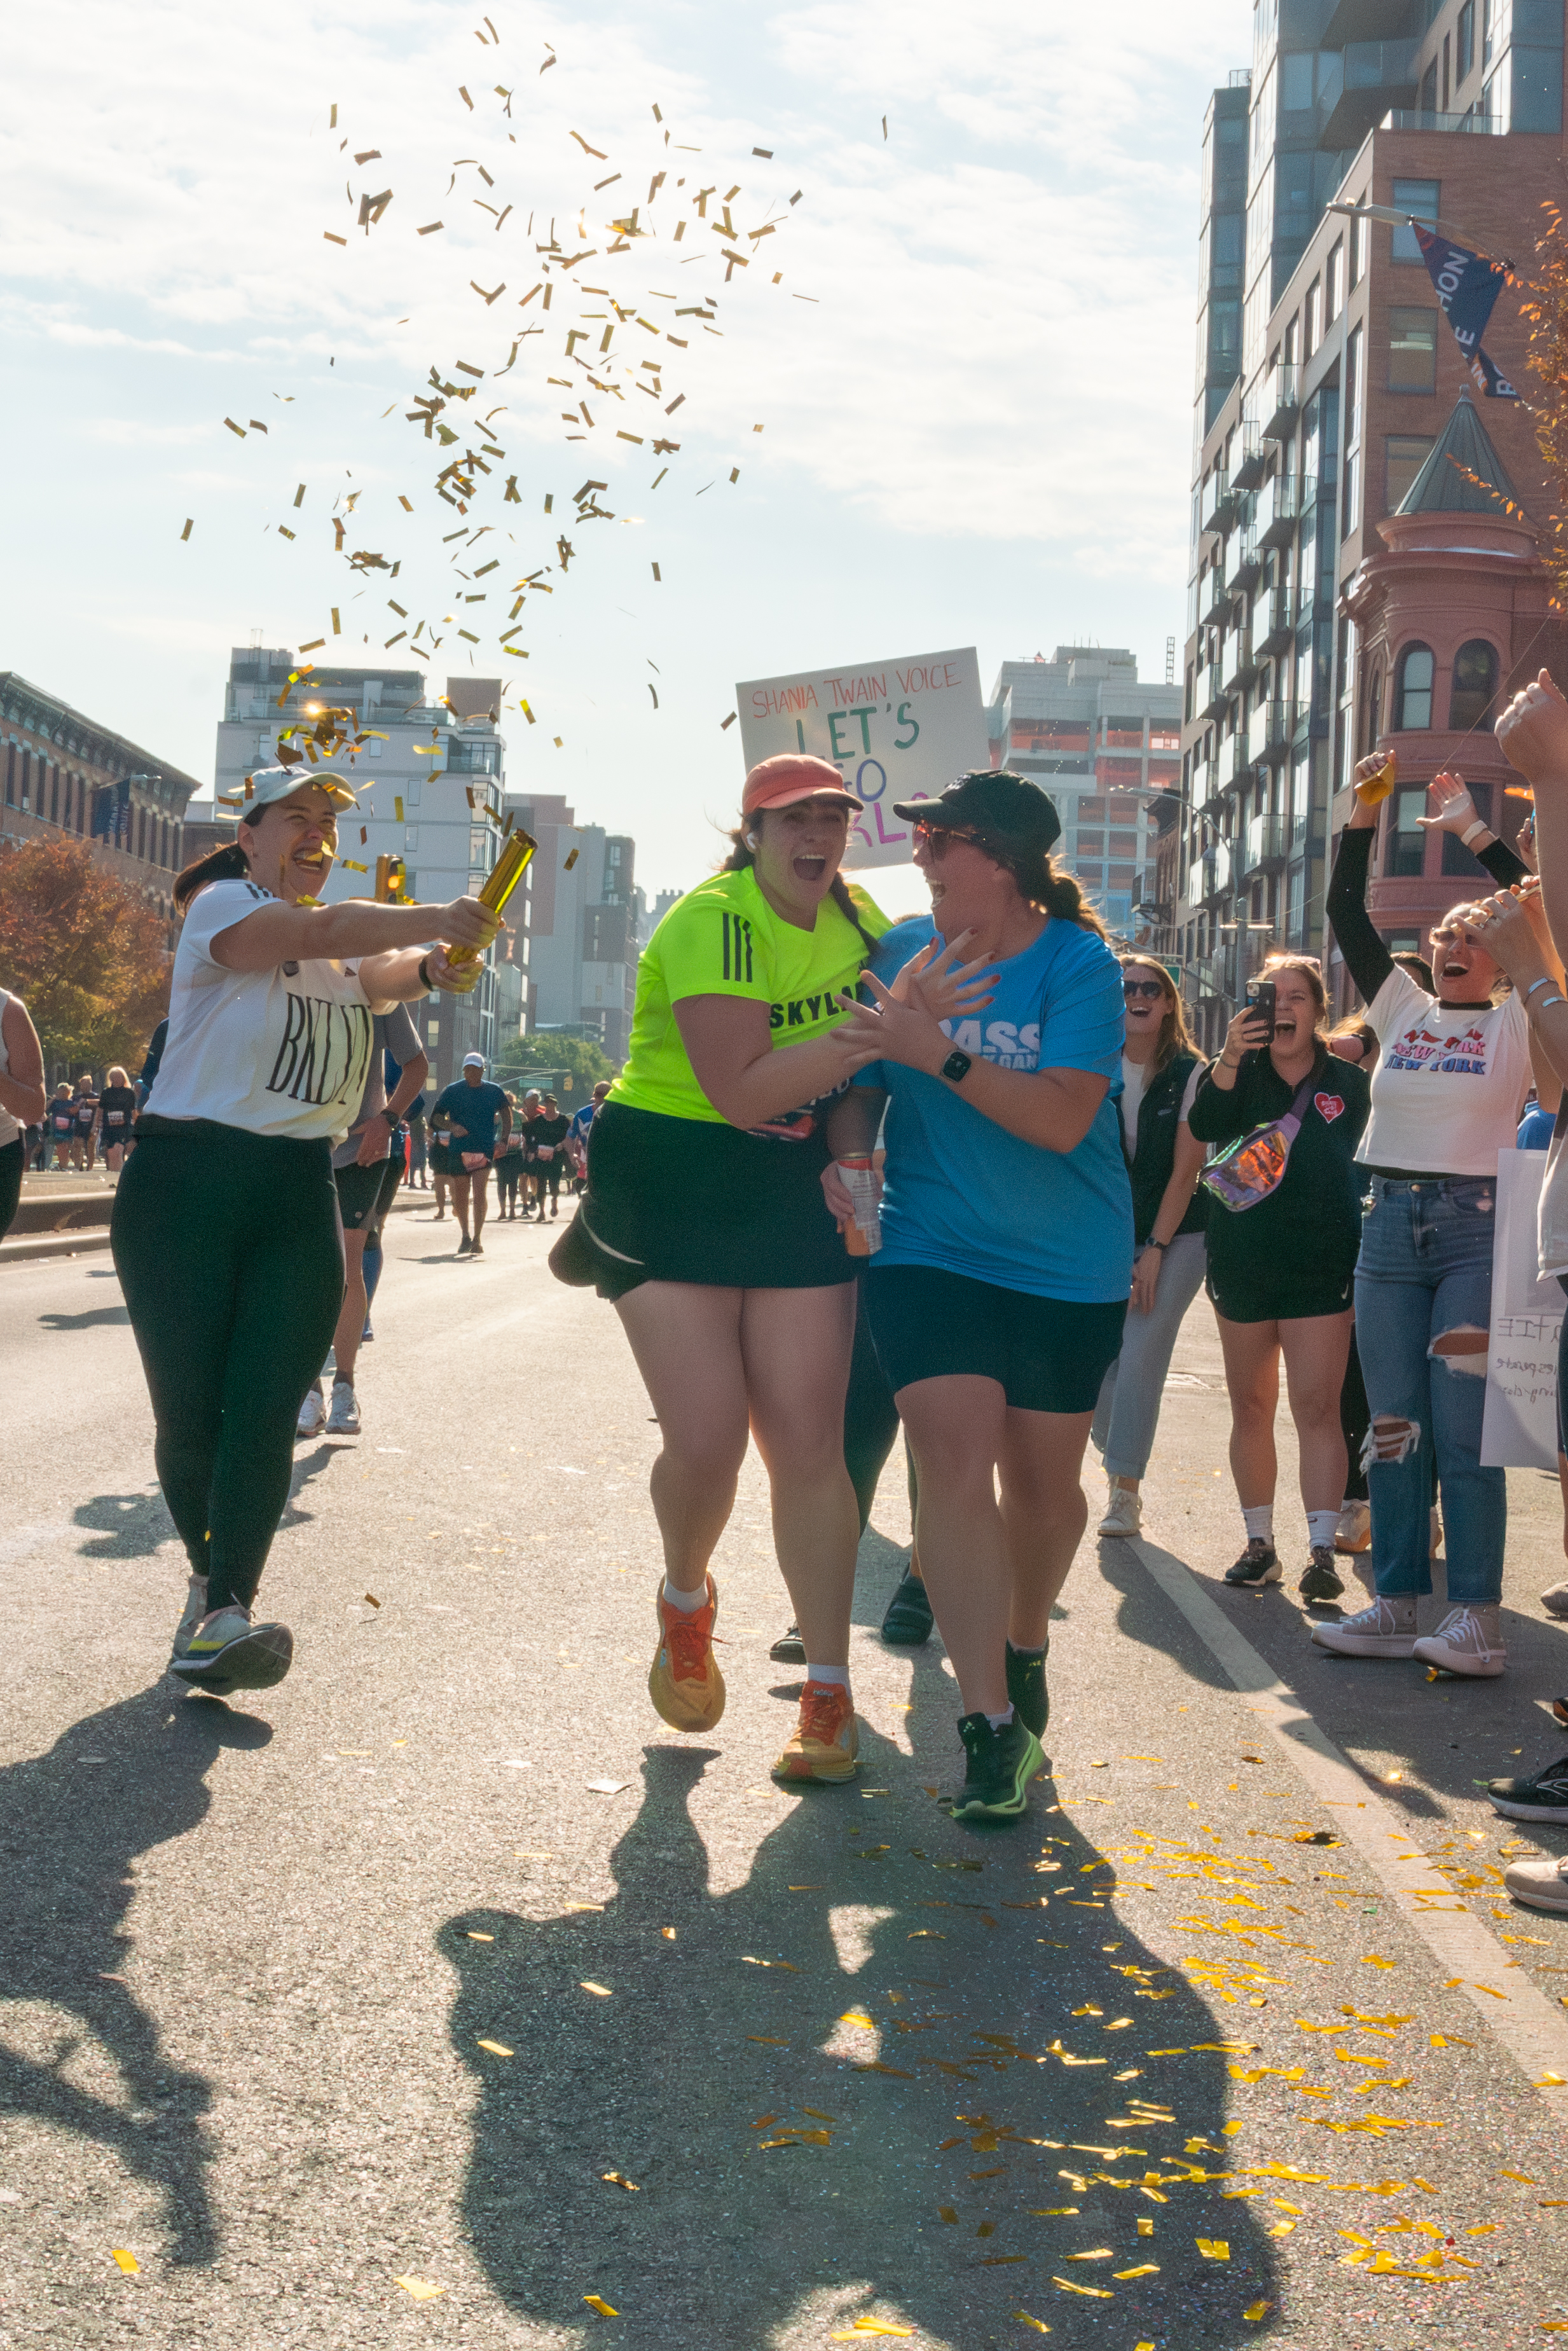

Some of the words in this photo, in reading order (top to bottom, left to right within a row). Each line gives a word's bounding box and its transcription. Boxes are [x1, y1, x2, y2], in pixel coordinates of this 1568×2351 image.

[752, 685, 818, 719] SHANIA
[824, 672, 888, 705] TWAIN
[896, 662, 962, 694] VOICE
[834, 759, 887, 802] O
[938, 1019, 1040, 1054] ASS
